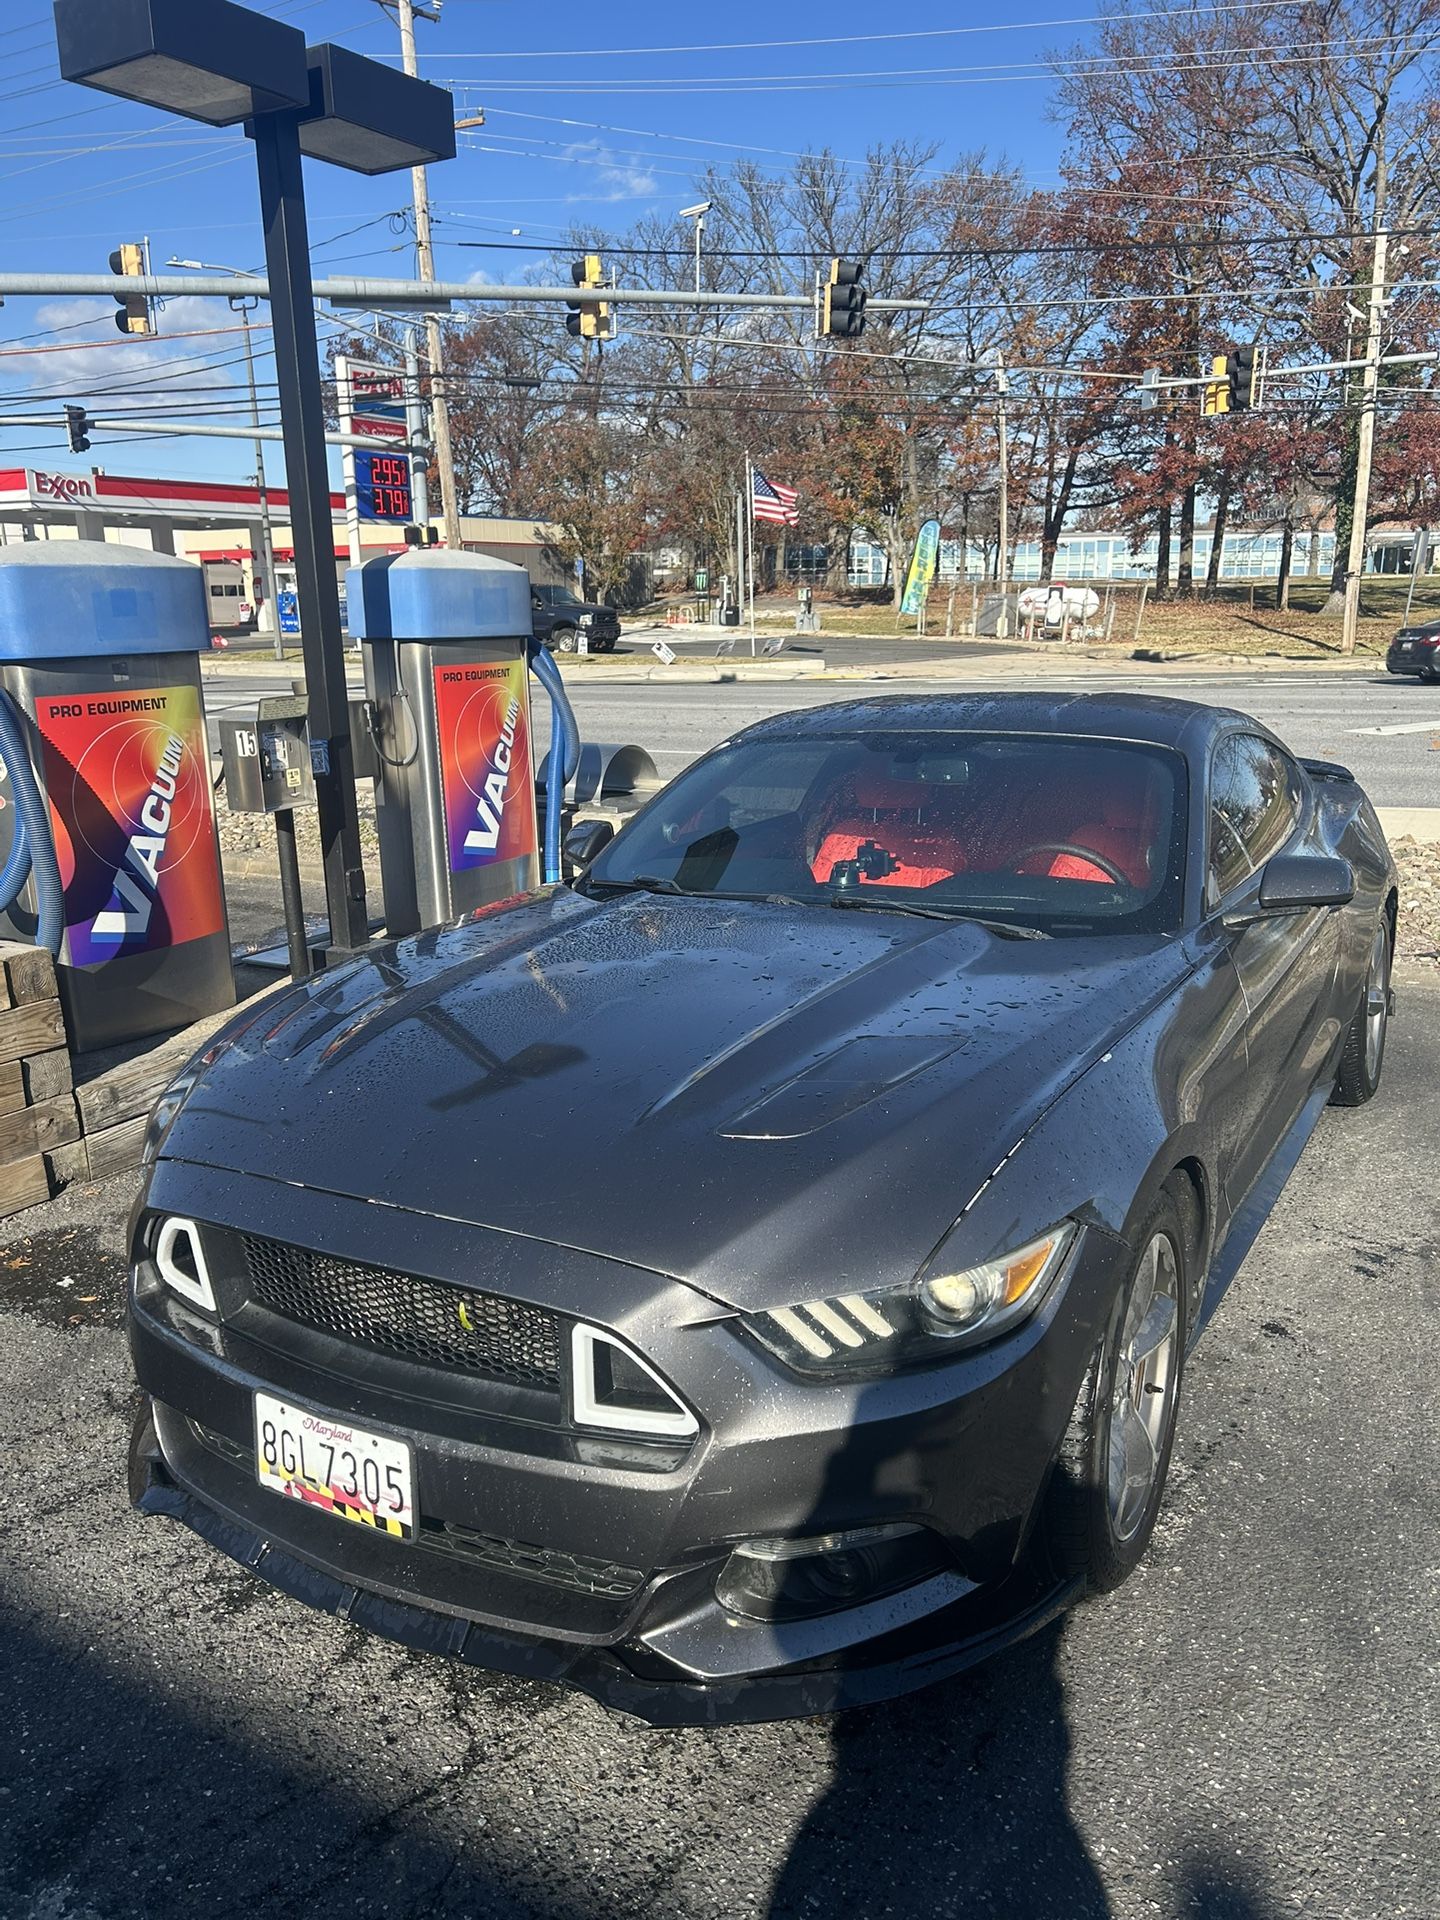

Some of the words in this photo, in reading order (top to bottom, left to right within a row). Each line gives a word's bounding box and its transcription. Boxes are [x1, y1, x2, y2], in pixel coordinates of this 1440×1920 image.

[36, 472, 92, 503] Exxon
[442, 671, 463, 682] PRO
[465, 668, 510, 681] EQUIPMENT
[49, 702, 83, 719] PRO
[87, 697, 168, 715] EQUIPMENT
[237, 731, 257, 757] 15
[464, 697, 520, 855] VACUUM
[90, 734, 184, 943] VACUUM
[302, 1417, 353, 1443] Maryland
